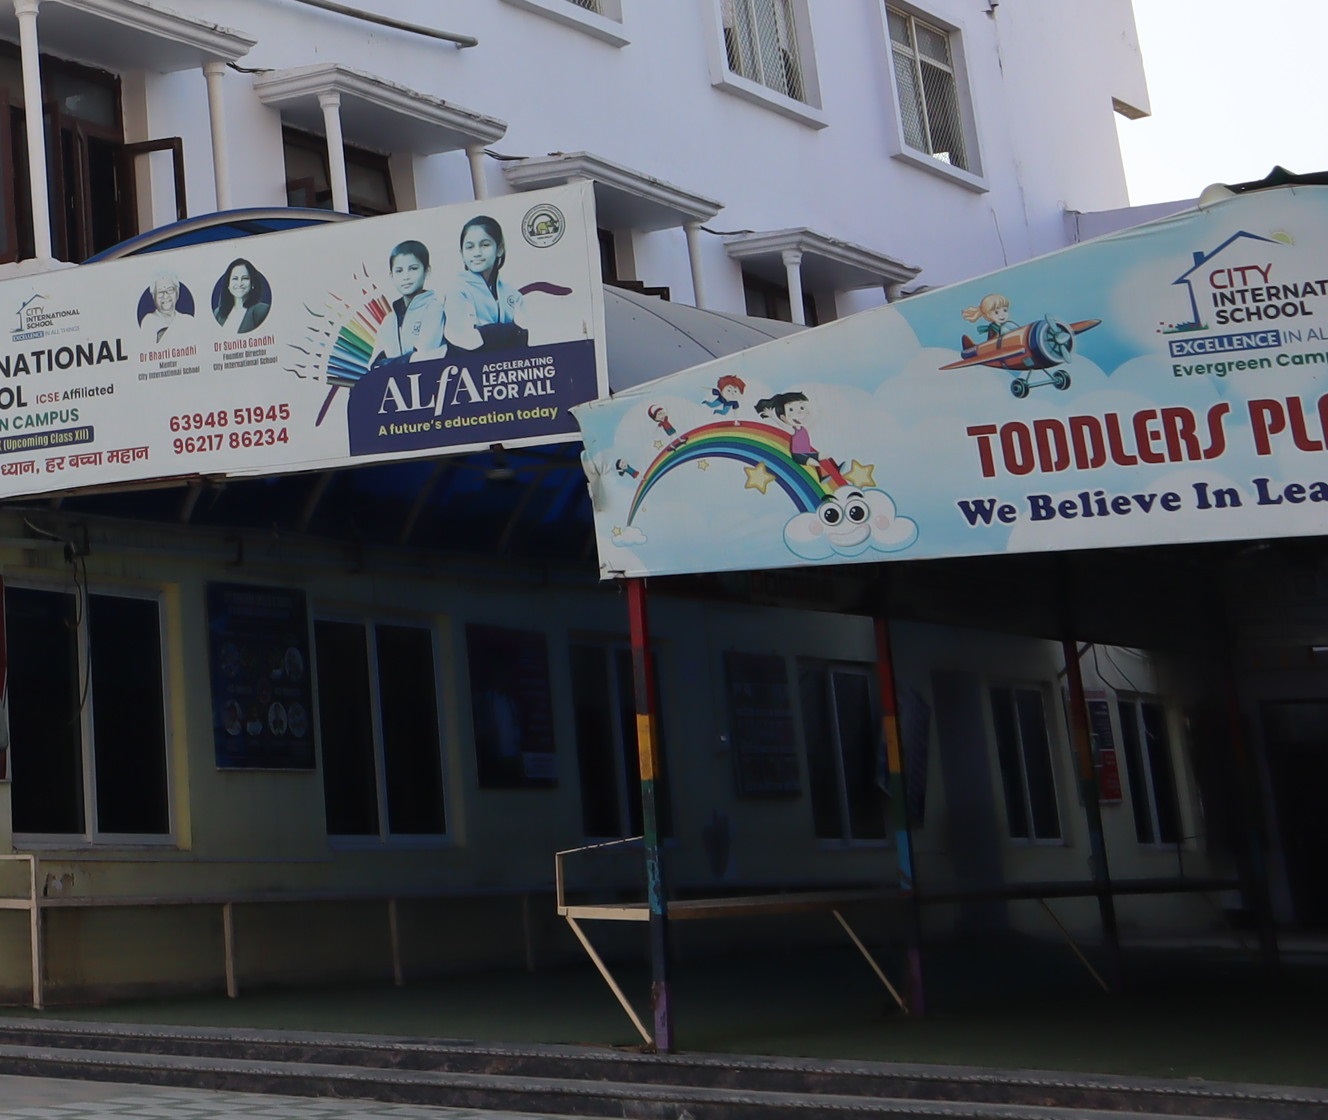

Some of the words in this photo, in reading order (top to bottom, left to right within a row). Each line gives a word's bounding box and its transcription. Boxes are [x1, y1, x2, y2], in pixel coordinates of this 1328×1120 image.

[1209, 263, 1272, 289] CITY
[26, 306, 44, 316] CITY
[26, 309, 80, 323] INTERNATIONAL
[1216, 300, 1313, 325] SCHOOL
[26, 320, 54, 330] SCHOOL
[214, 342, 222, 352] Dr
[223, 339, 247, 351] Sunita
[248, 334, 275, 348] Gandhi
[1171, 331, 1279, 356] EXCELLENCE
[1283, 328, 1303, 344] IN
[139, 352, 147, 363] Dr
[149, 347, 170, 360] Bharti
[172, 345, 197, 358] Gandhi
[159, 360, 177, 369] Mentor
[213, 363, 223, 371] City
[224, 359, 259, 370] International
[260, 356, 278, 366] School
[223, 351, 244, 360] Founder
[245, 349, 266, 358] Director
[482, 356, 554, 373] ACCELERATING
[1172, 356, 1272, 378] Evergreen
[1276, 351, 1328, 367] Cam
[138, 372, 147, 380] City
[149, 369, 182, 379] International
[183, 366, 200, 375] School
[482, 365, 556, 386] LEARNING
[35, 392, 60, 405] ICSE
[62, 384, 114, 401] Affiliated
[483, 384, 519, 402] FOR
[523, 379, 555, 397] ALL
[12, 408, 80, 430] CAMPUS
[169, 410, 228, 433] 63948
[234, 403, 290, 425] 51945
[379, 425, 387, 436] A
[390, 420, 442, 435] future's
[445, 411, 514, 429] education
[517, 407, 558, 423] today
[3, 433, 49, 451] (Upcoming
[50, 432, 73, 444] Class
[74, 428, 89, 441] XII)
[173, 434, 224, 455] 96217
[228, 427, 289, 449] 86234
[967, 402, 1230, 478] TODDLERS
[0, 460, 40, 476] ध्यान,
[45, 456, 65, 473] हर
[68, 451, 103, 468] बच्चा
[107, 445, 149, 464] महान
[957, 498, 1017, 526] We
[1026, 490, 1182, 522] Believe
[1192, 482, 1243, 510] In
